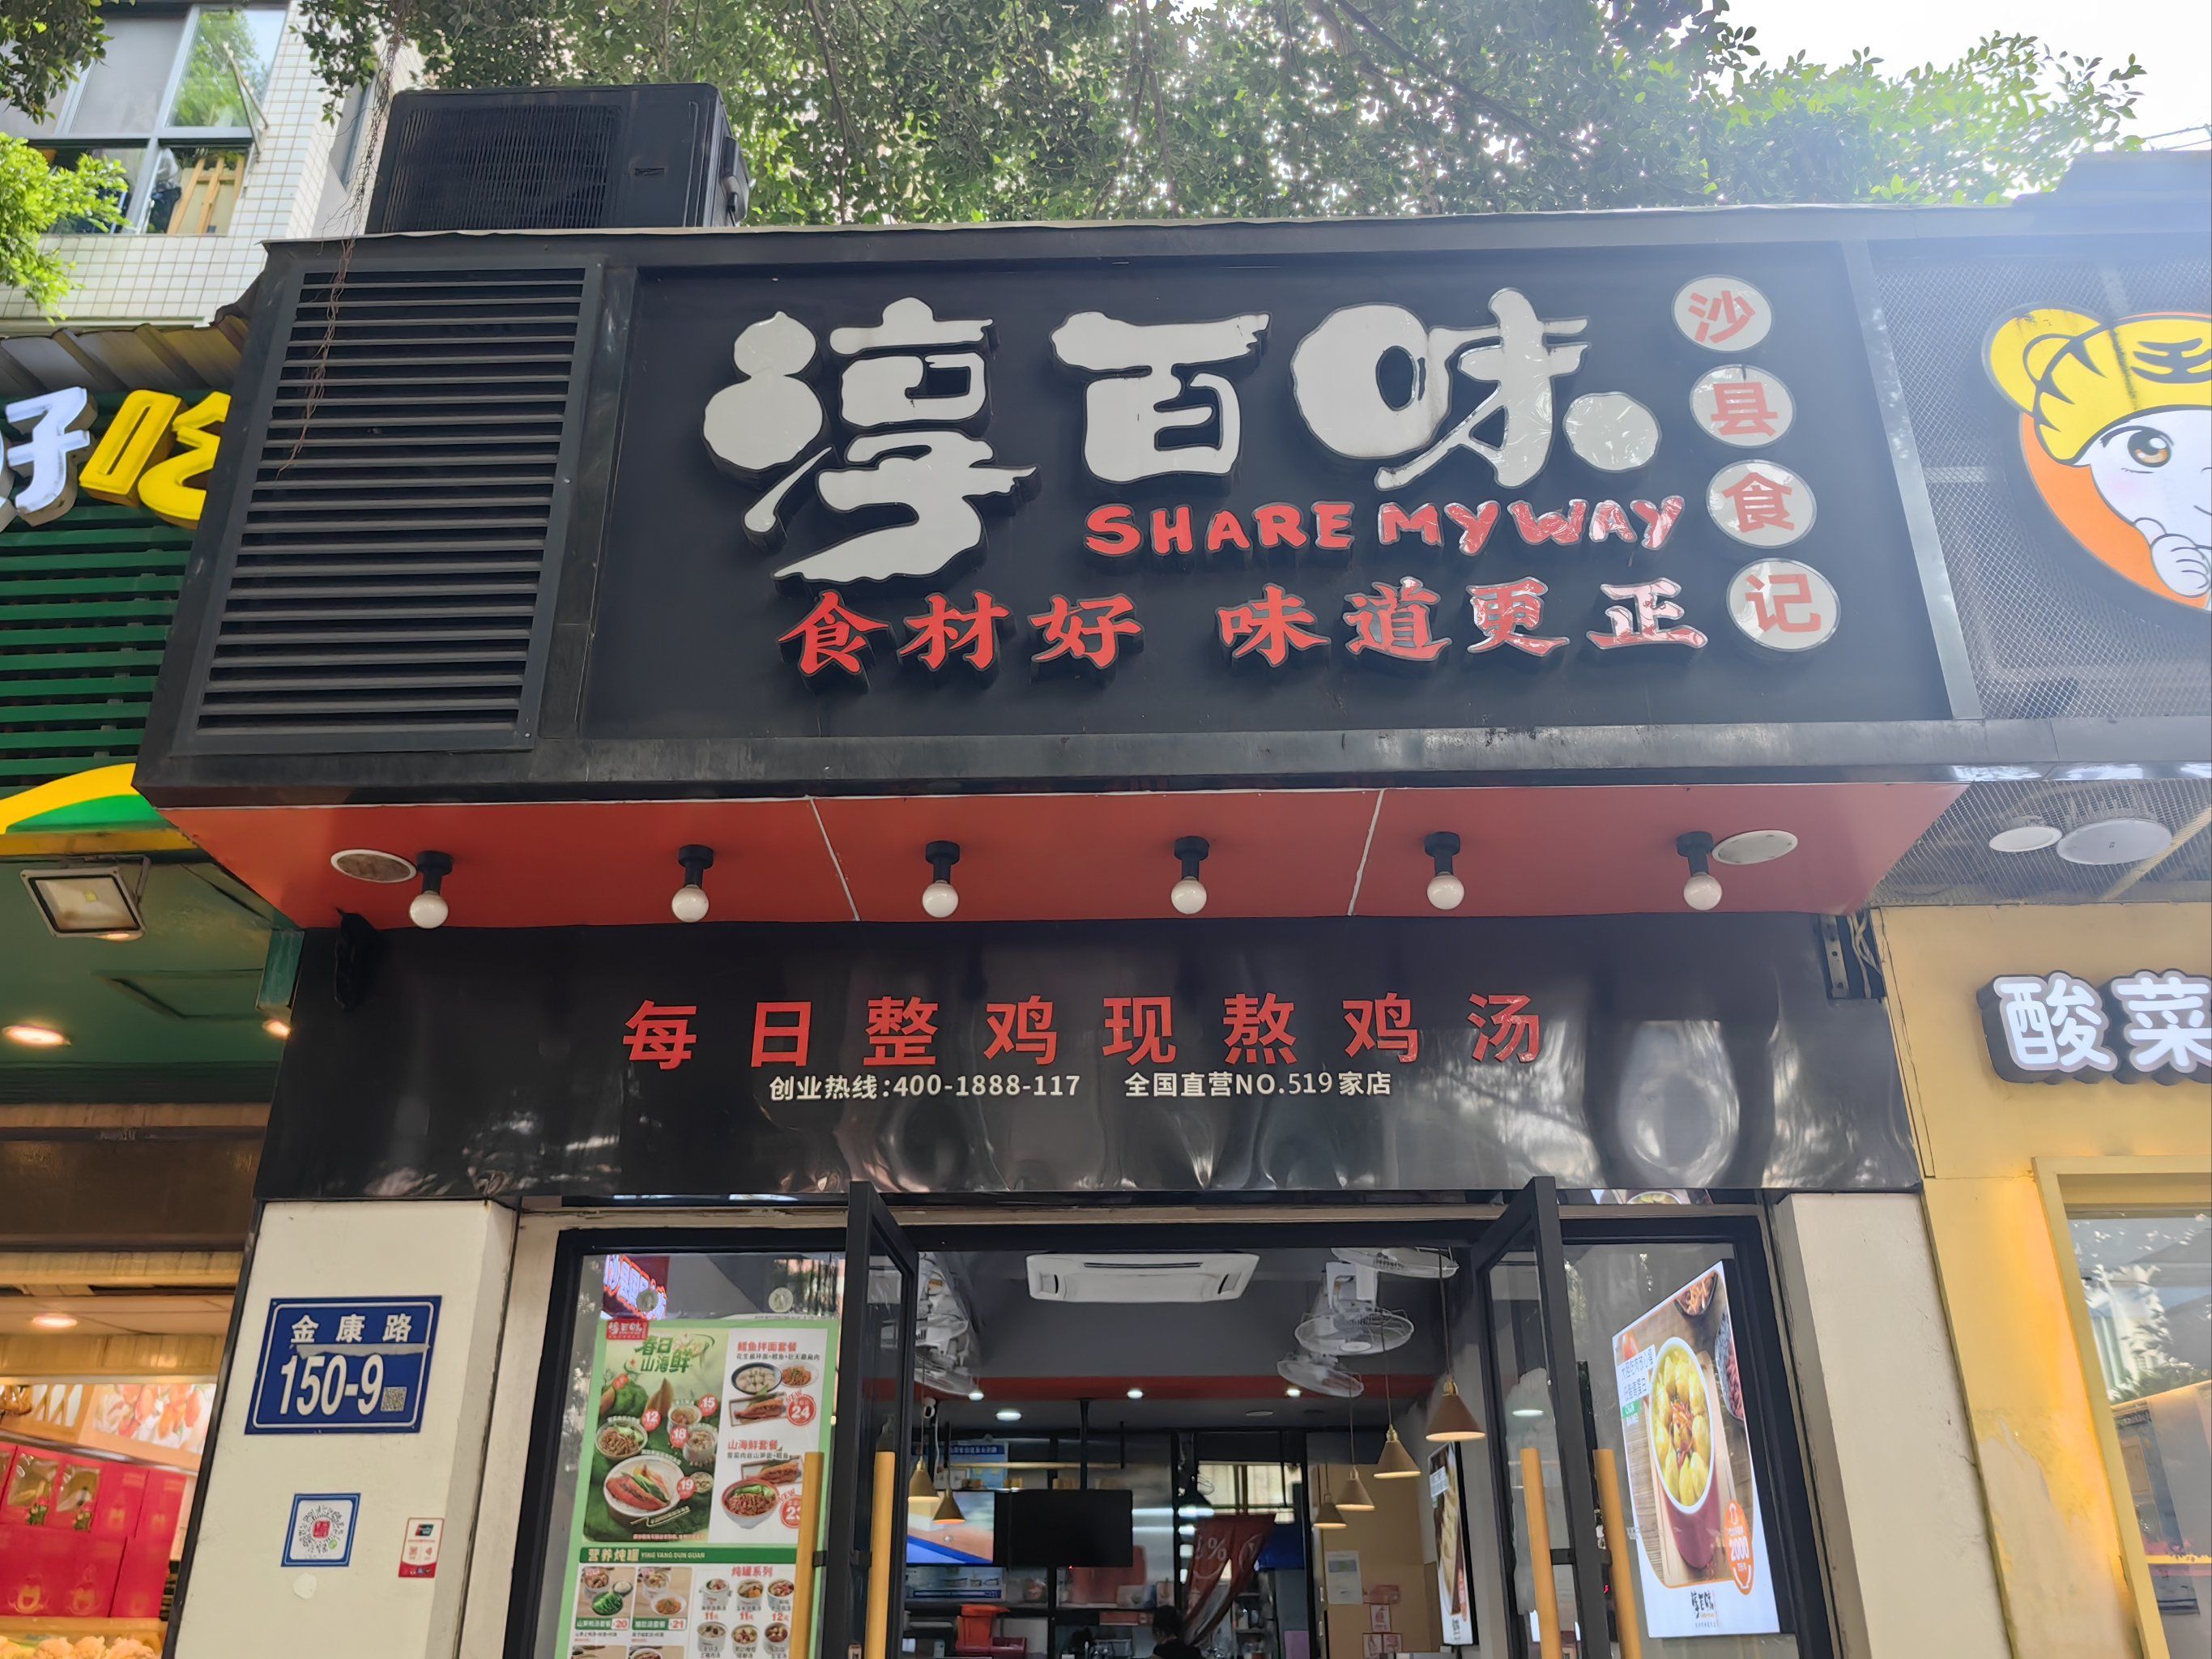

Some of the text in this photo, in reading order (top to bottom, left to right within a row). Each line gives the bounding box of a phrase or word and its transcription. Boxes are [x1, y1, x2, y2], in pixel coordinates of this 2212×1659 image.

[0, 386, 232, 522] 子吃
[1688, 290, 1822, 633] 沙县食记
[1085, 502, 1354, 556] SHARE
[778, 576, 1707, 676] 食材好 味道更正
[623, 992, 1541, 1070] 每日整鸡现熬鸡汤
[2001, 976, 2212, 1067] 酸菜
[291, 1313, 411, 1344] 金康路
[641, 1349, 691, 1373] 山海鲜
[279, 1354, 384, 1417] 150-9
[645, 1410, 658, 1423] 12
[702, 1397, 716, 1409] 15
[791, 1405, 811, 1419] 24
[674, 1428, 687, 1440] 18
[727, 1439, 778, 1450] 山海鲜套餐
[680, 1480, 694, 1492] 19
